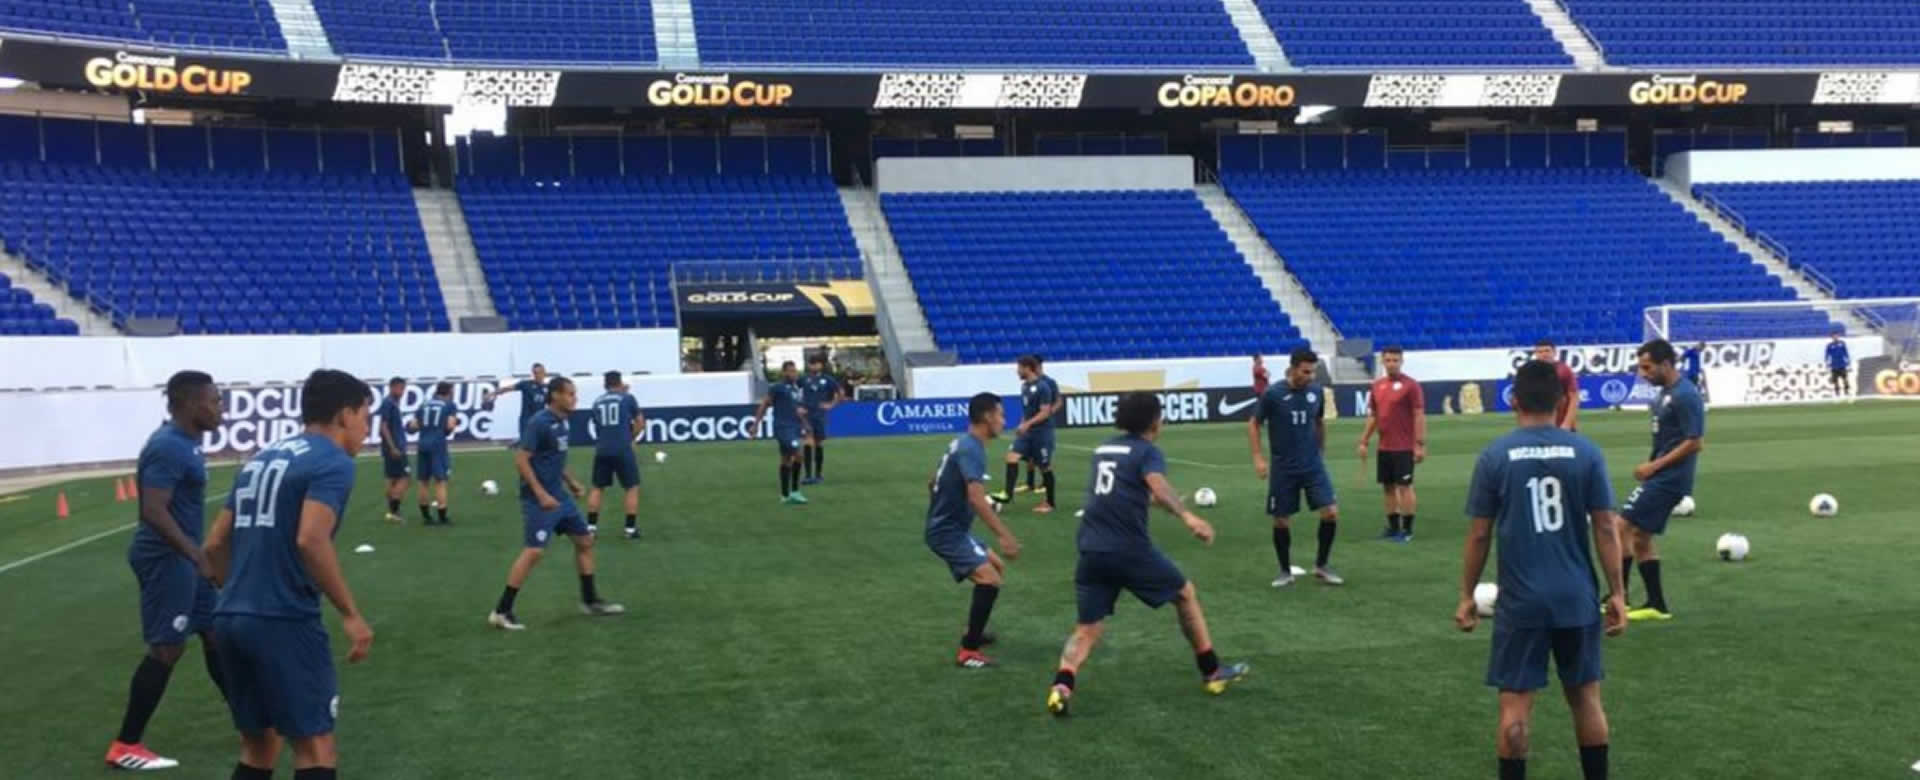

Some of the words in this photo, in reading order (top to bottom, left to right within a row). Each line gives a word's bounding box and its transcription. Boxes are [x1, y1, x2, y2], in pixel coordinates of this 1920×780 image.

[85, 57, 178, 92] GOLD
[181, 65, 252, 94] CUP
[648, 80, 731, 106] GOLD
[733, 80, 793, 106] CUP
[1157, 82, 1233, 107] COPA
[1234, 82, 1294, 107] ORO
[1629, 81, 1697, 104] GOLD
[1698, 81, 1748, 104] CUP
[423, 406, 442, 427] 17
[599, 402, 619, 426] 10
[1066, 395, 1120, 425] NIKE
[1094, 461, 1117, 495] 15
[234, 458, 290, 529] 20
[1526, 476, 1564, 533] 18
